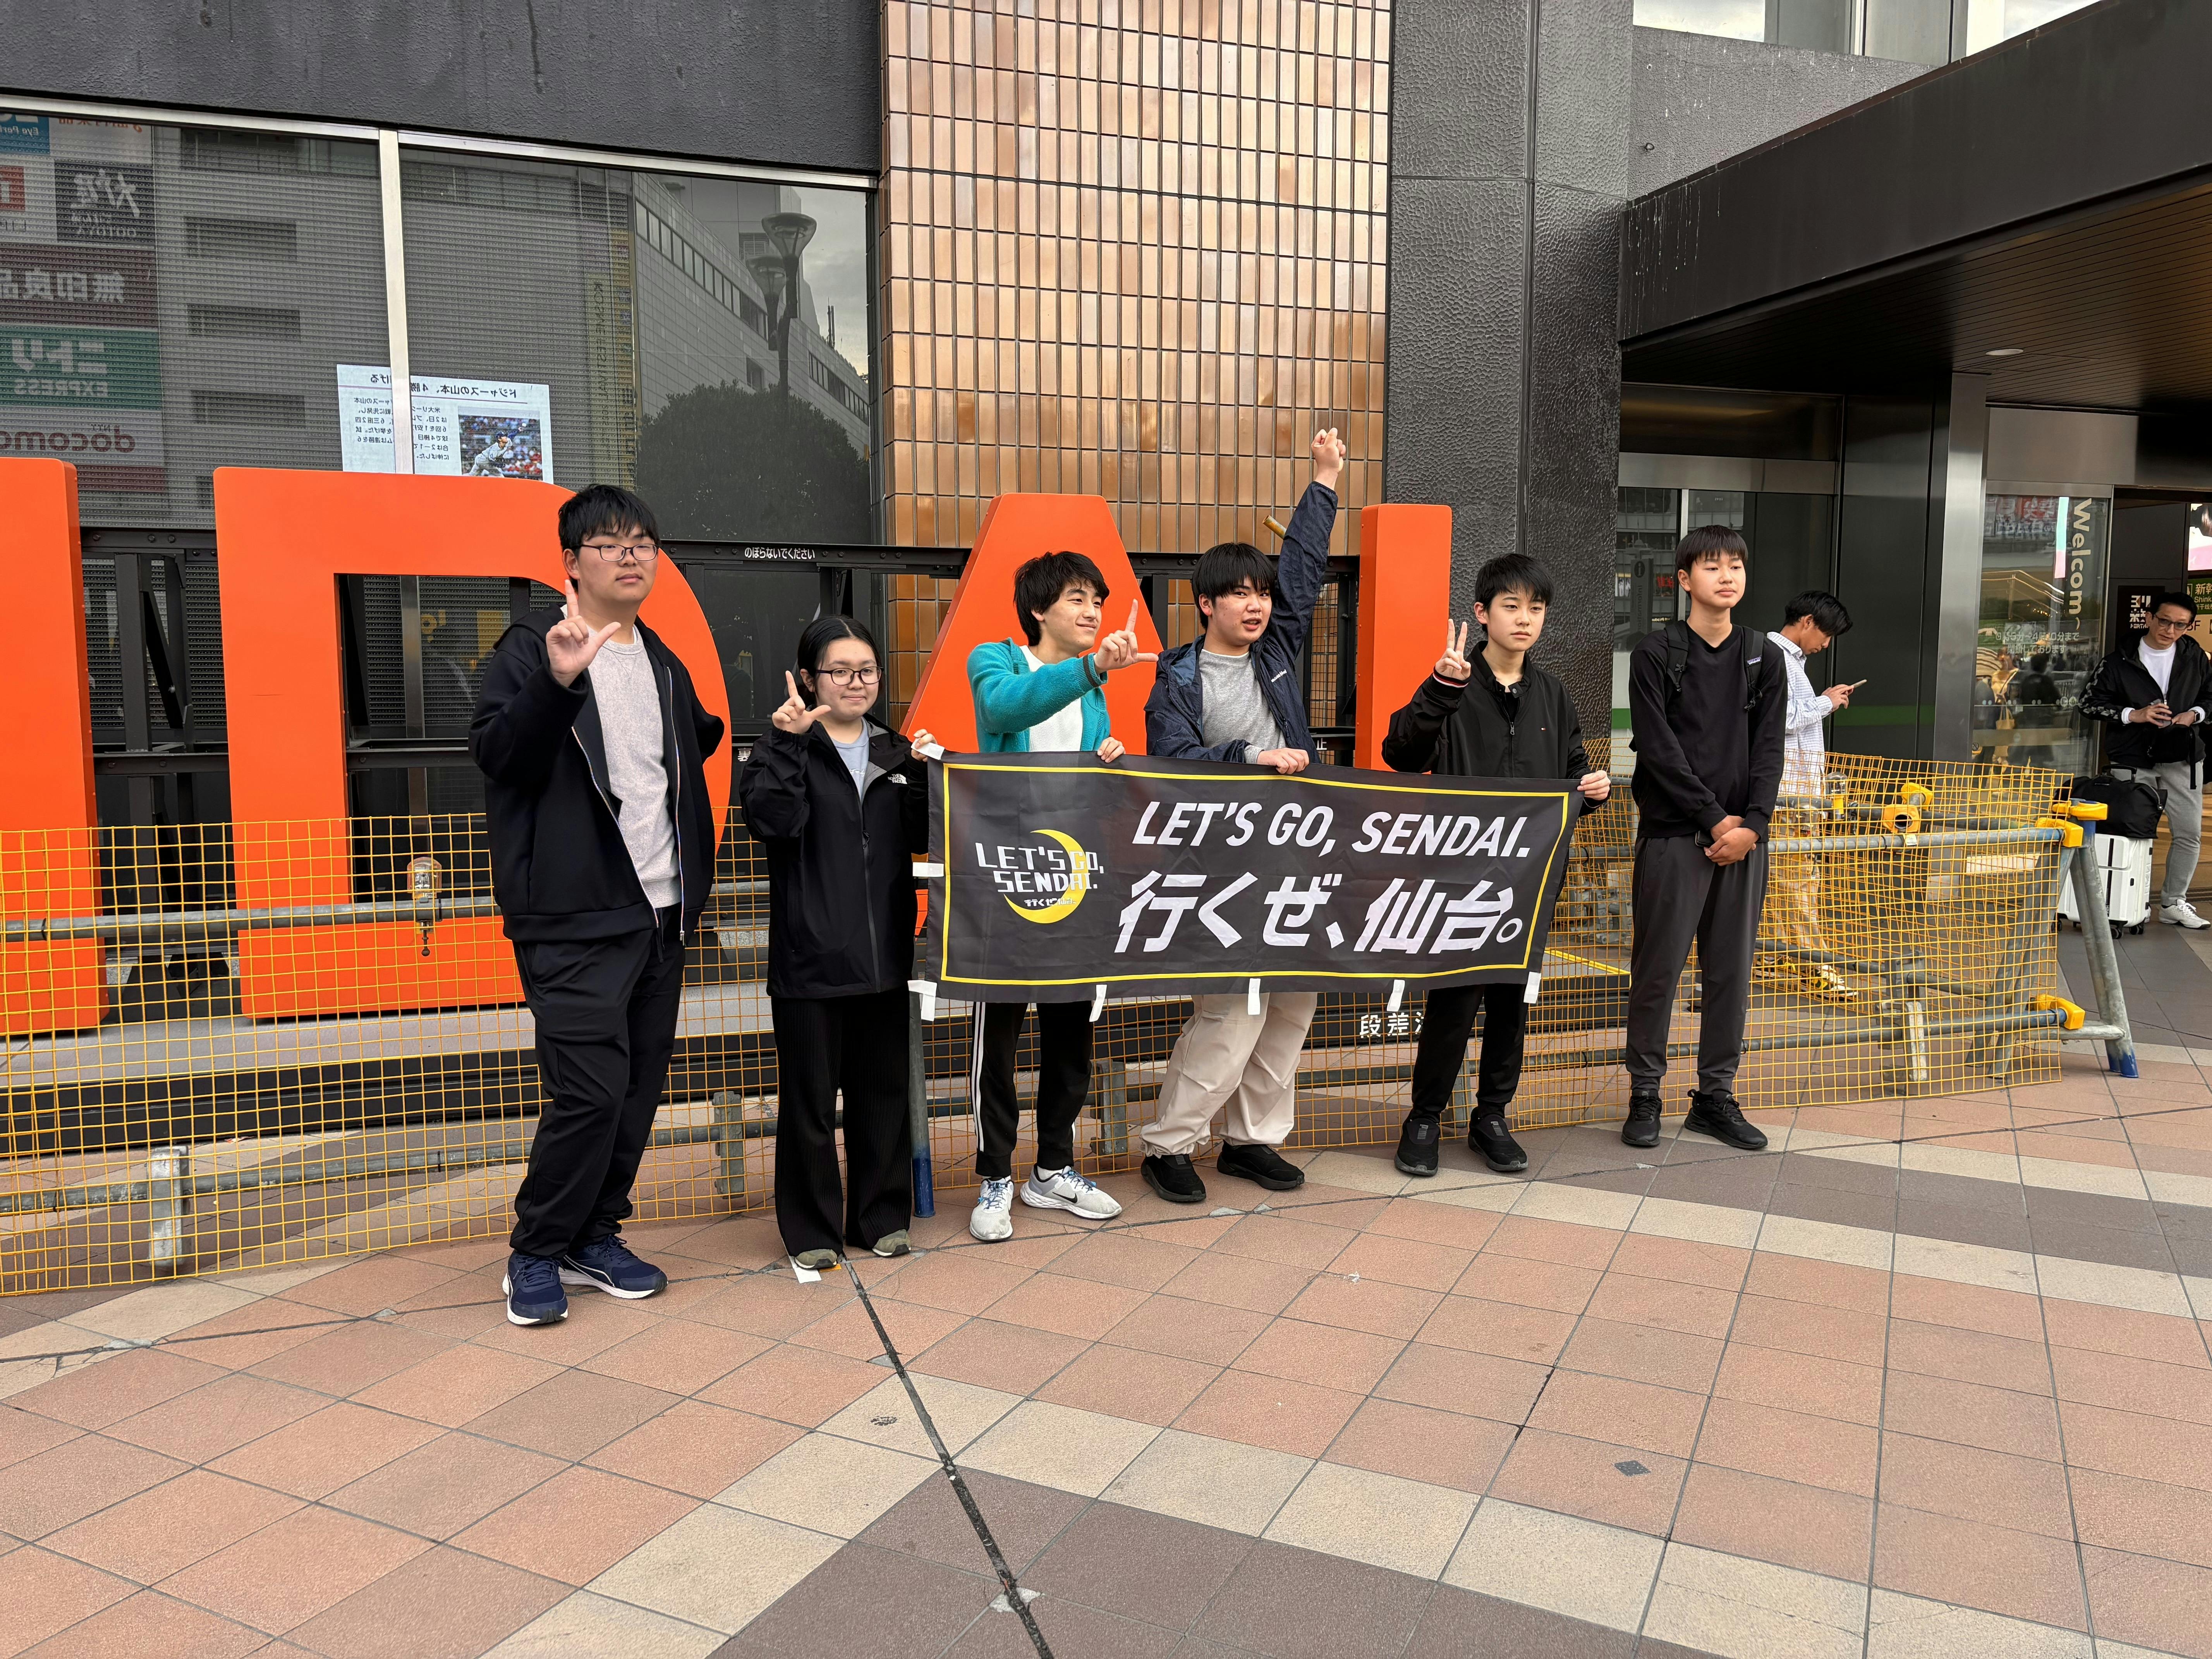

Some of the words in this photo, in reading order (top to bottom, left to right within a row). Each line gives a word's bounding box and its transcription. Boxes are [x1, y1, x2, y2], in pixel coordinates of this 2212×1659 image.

[744, 547, 815, 560] のぼらないでください
[2069, 498, 2092, 630] Welcom
[1132, 801, 1262, 847] LET'S
[1267, 802, 1336, 858] GO,
[1352, 811, 1530, 858] SENDAI.
[975, 842, 1066, 870] LET'S
[1069, 851, 1104, 874] GO,
[993, 871, 1097, 893] SENDAI.
[1114, 870, 1524, 954] 行くぜ、仙台。
